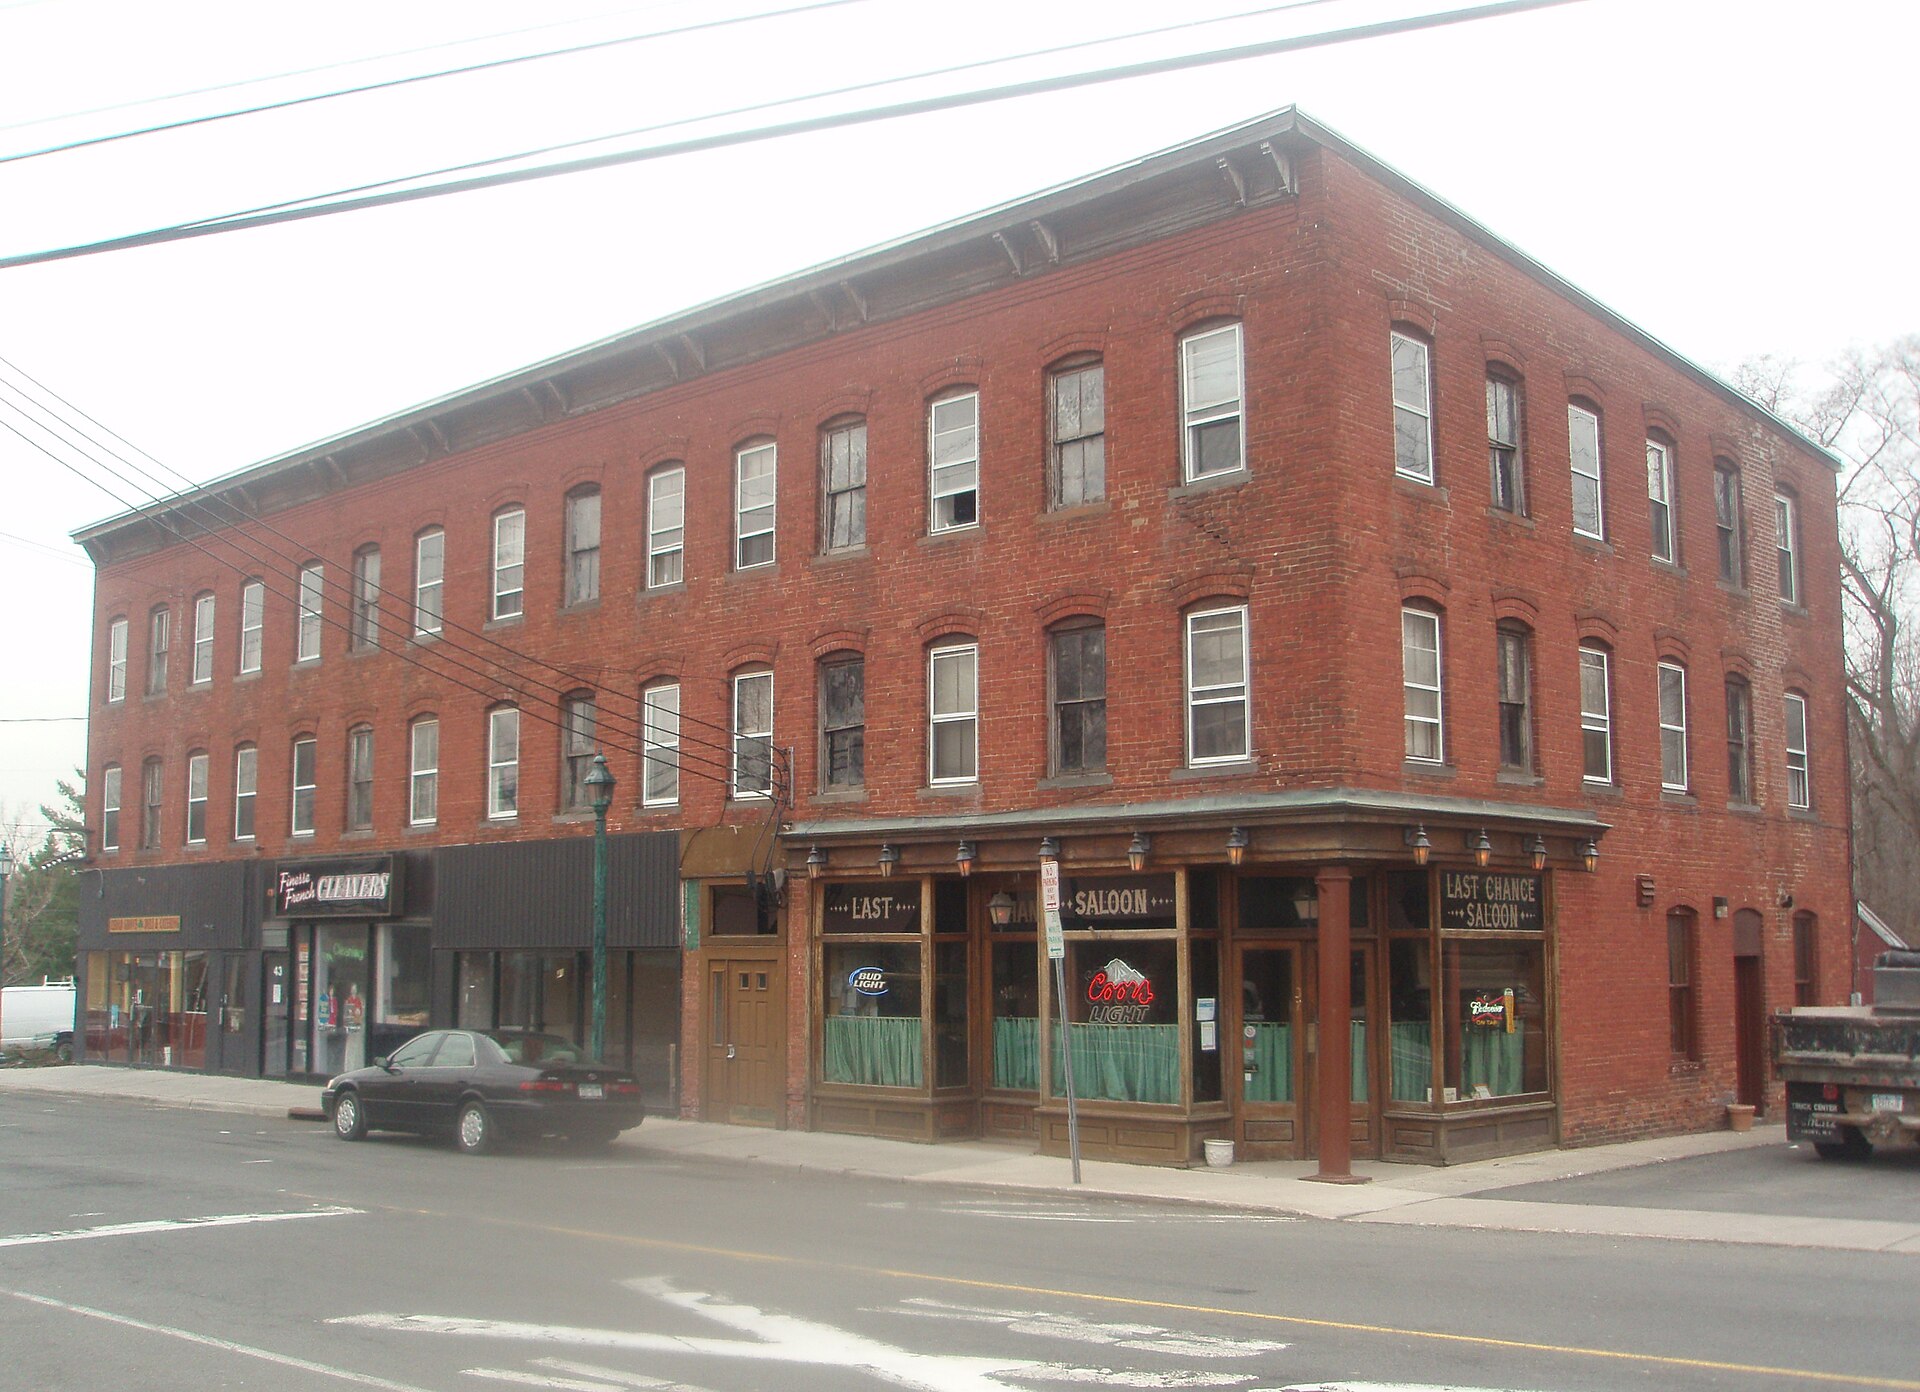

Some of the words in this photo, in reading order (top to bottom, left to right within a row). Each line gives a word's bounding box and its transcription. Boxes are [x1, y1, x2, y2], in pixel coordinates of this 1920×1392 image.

[280, 872, 310, 893] Finesse
[317, 872, 390, 901] CLEANERS
[1042, 878, 1058, 887] PARKING
[1446, 873, 1479, 899] LAST
[1485, 875, 1536, 902] CHANCE
[286, 881, 315, 909] French
[1075, 889, 1147, 915] SALOON
[852, 897, 893, 919] LAST
[1466, 902, 1518, 928] SALOON
[273, 966, 283, 977] 43
[858, 972, 882, 981] BUD
[853, 981, 886, 989] LIGHT
[1088, 972, 1154, 1005] Coors
[1088, 1005, 1150, 1023] LIGHT
[1813, 1103, 1838, 1112] CENTER
